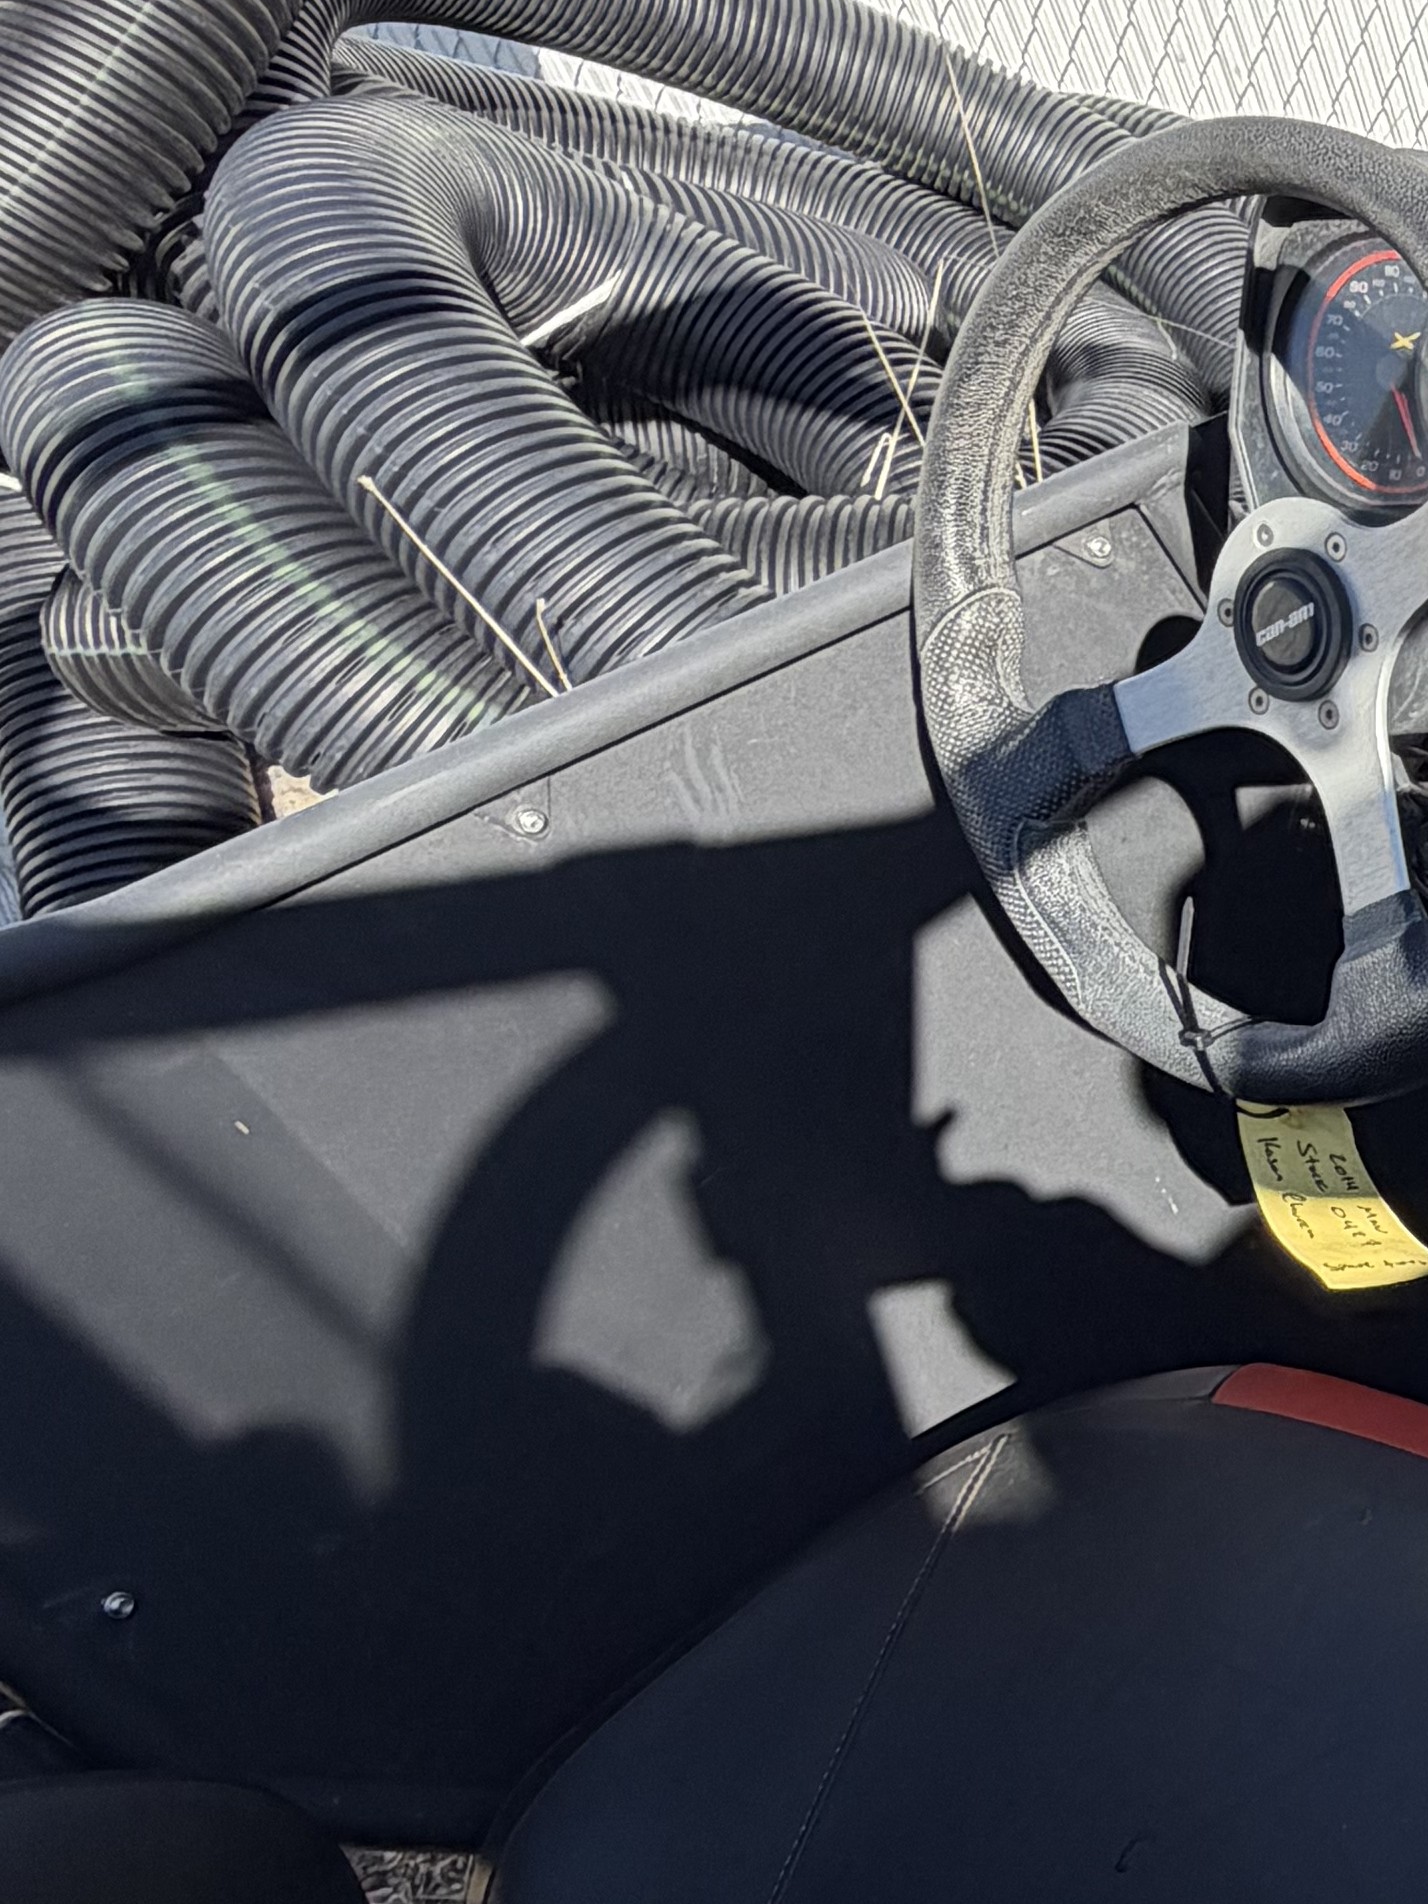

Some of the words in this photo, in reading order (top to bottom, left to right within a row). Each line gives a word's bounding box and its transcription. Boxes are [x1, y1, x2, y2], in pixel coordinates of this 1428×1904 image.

[1327, 314, 1344, 327] 70
[1315, 381, 1334, 394] 50
[1323, 414, 1342, 426] 40
[1361, 460, 1379, 472] 20
[1416, 466, 1426, 477] 0
[1389, 469, 1402, 481] 10
